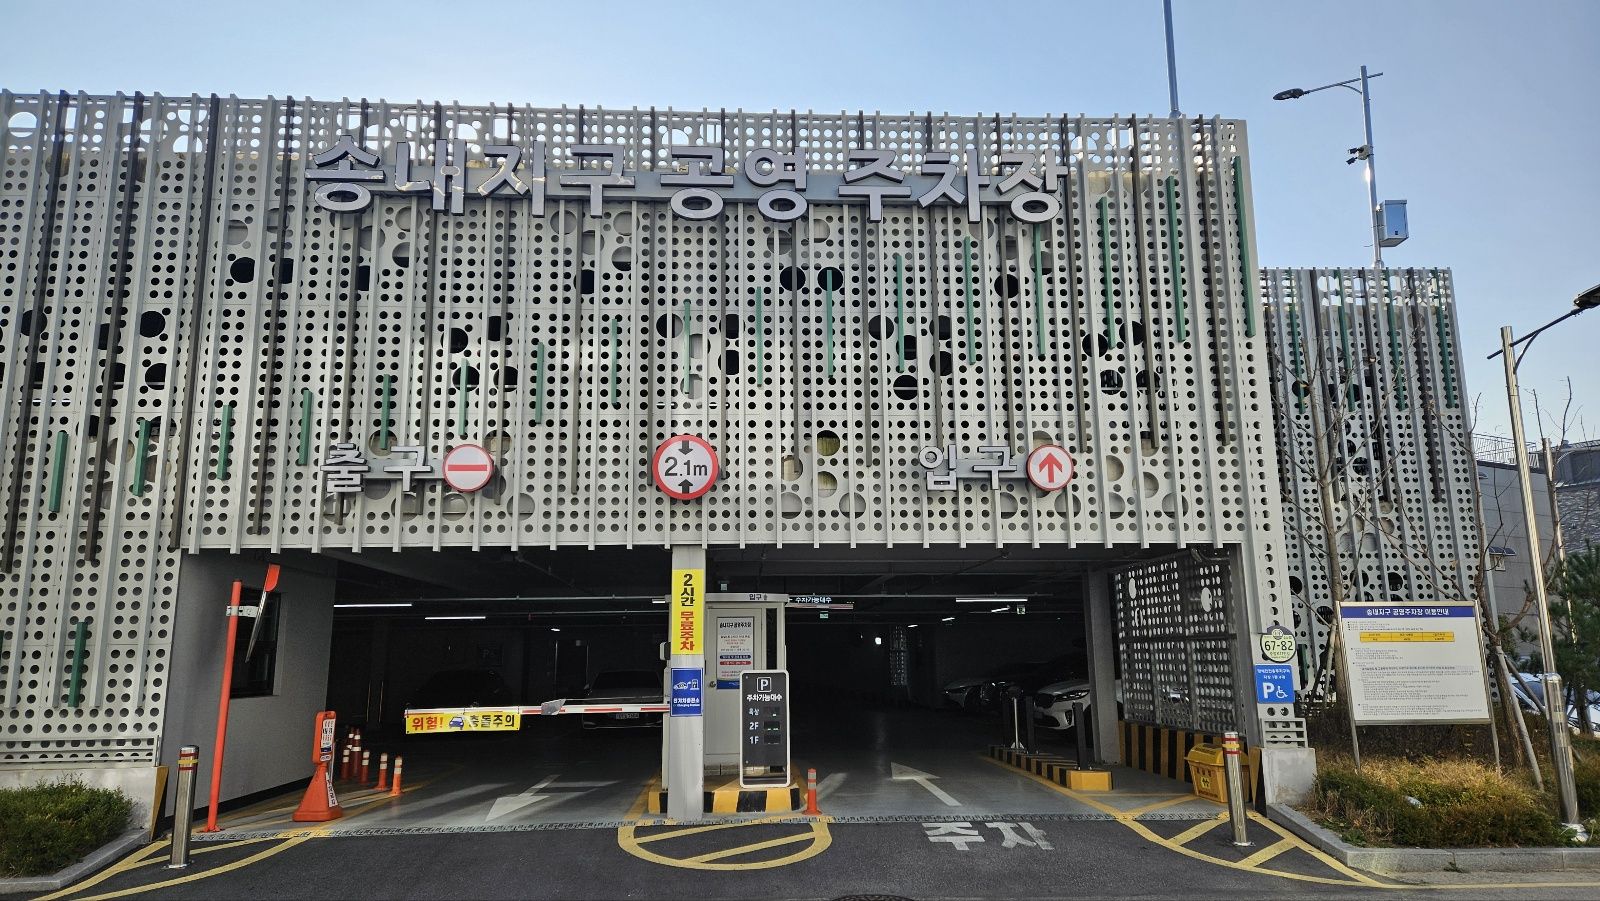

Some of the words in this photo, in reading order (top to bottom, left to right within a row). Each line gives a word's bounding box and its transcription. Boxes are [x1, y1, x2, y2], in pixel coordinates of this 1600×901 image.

[304, 134, 636, 218] 송내지구
[660, 145, 808, 222] 공영
[838, 147, 1068, 224] 주차장
[320, 442, 433, 493] 출구
[664, 456, 708, 477] 2.1m
[918, 444, 1018, 491] 입구
[680, 573, 695, 607] 2시간
[749, 593, 762, 601] 입구
[795, 596, 832, 604] 주차가능대수
[680, 611, 695, 651] 무료주차
[1264, 640, 1294, 651] 67-82
[760, 679, 769, 691] P
[1262, 682, 1275, 699] P
[746, 694, 783, 702] 주차가능대수
[411, 716, 444, 731] 위험!
[468, 714, 515, 728] 충돌주의
[749, 722, 759, 731] 2F
[749, 736, 760, 745] 1F
